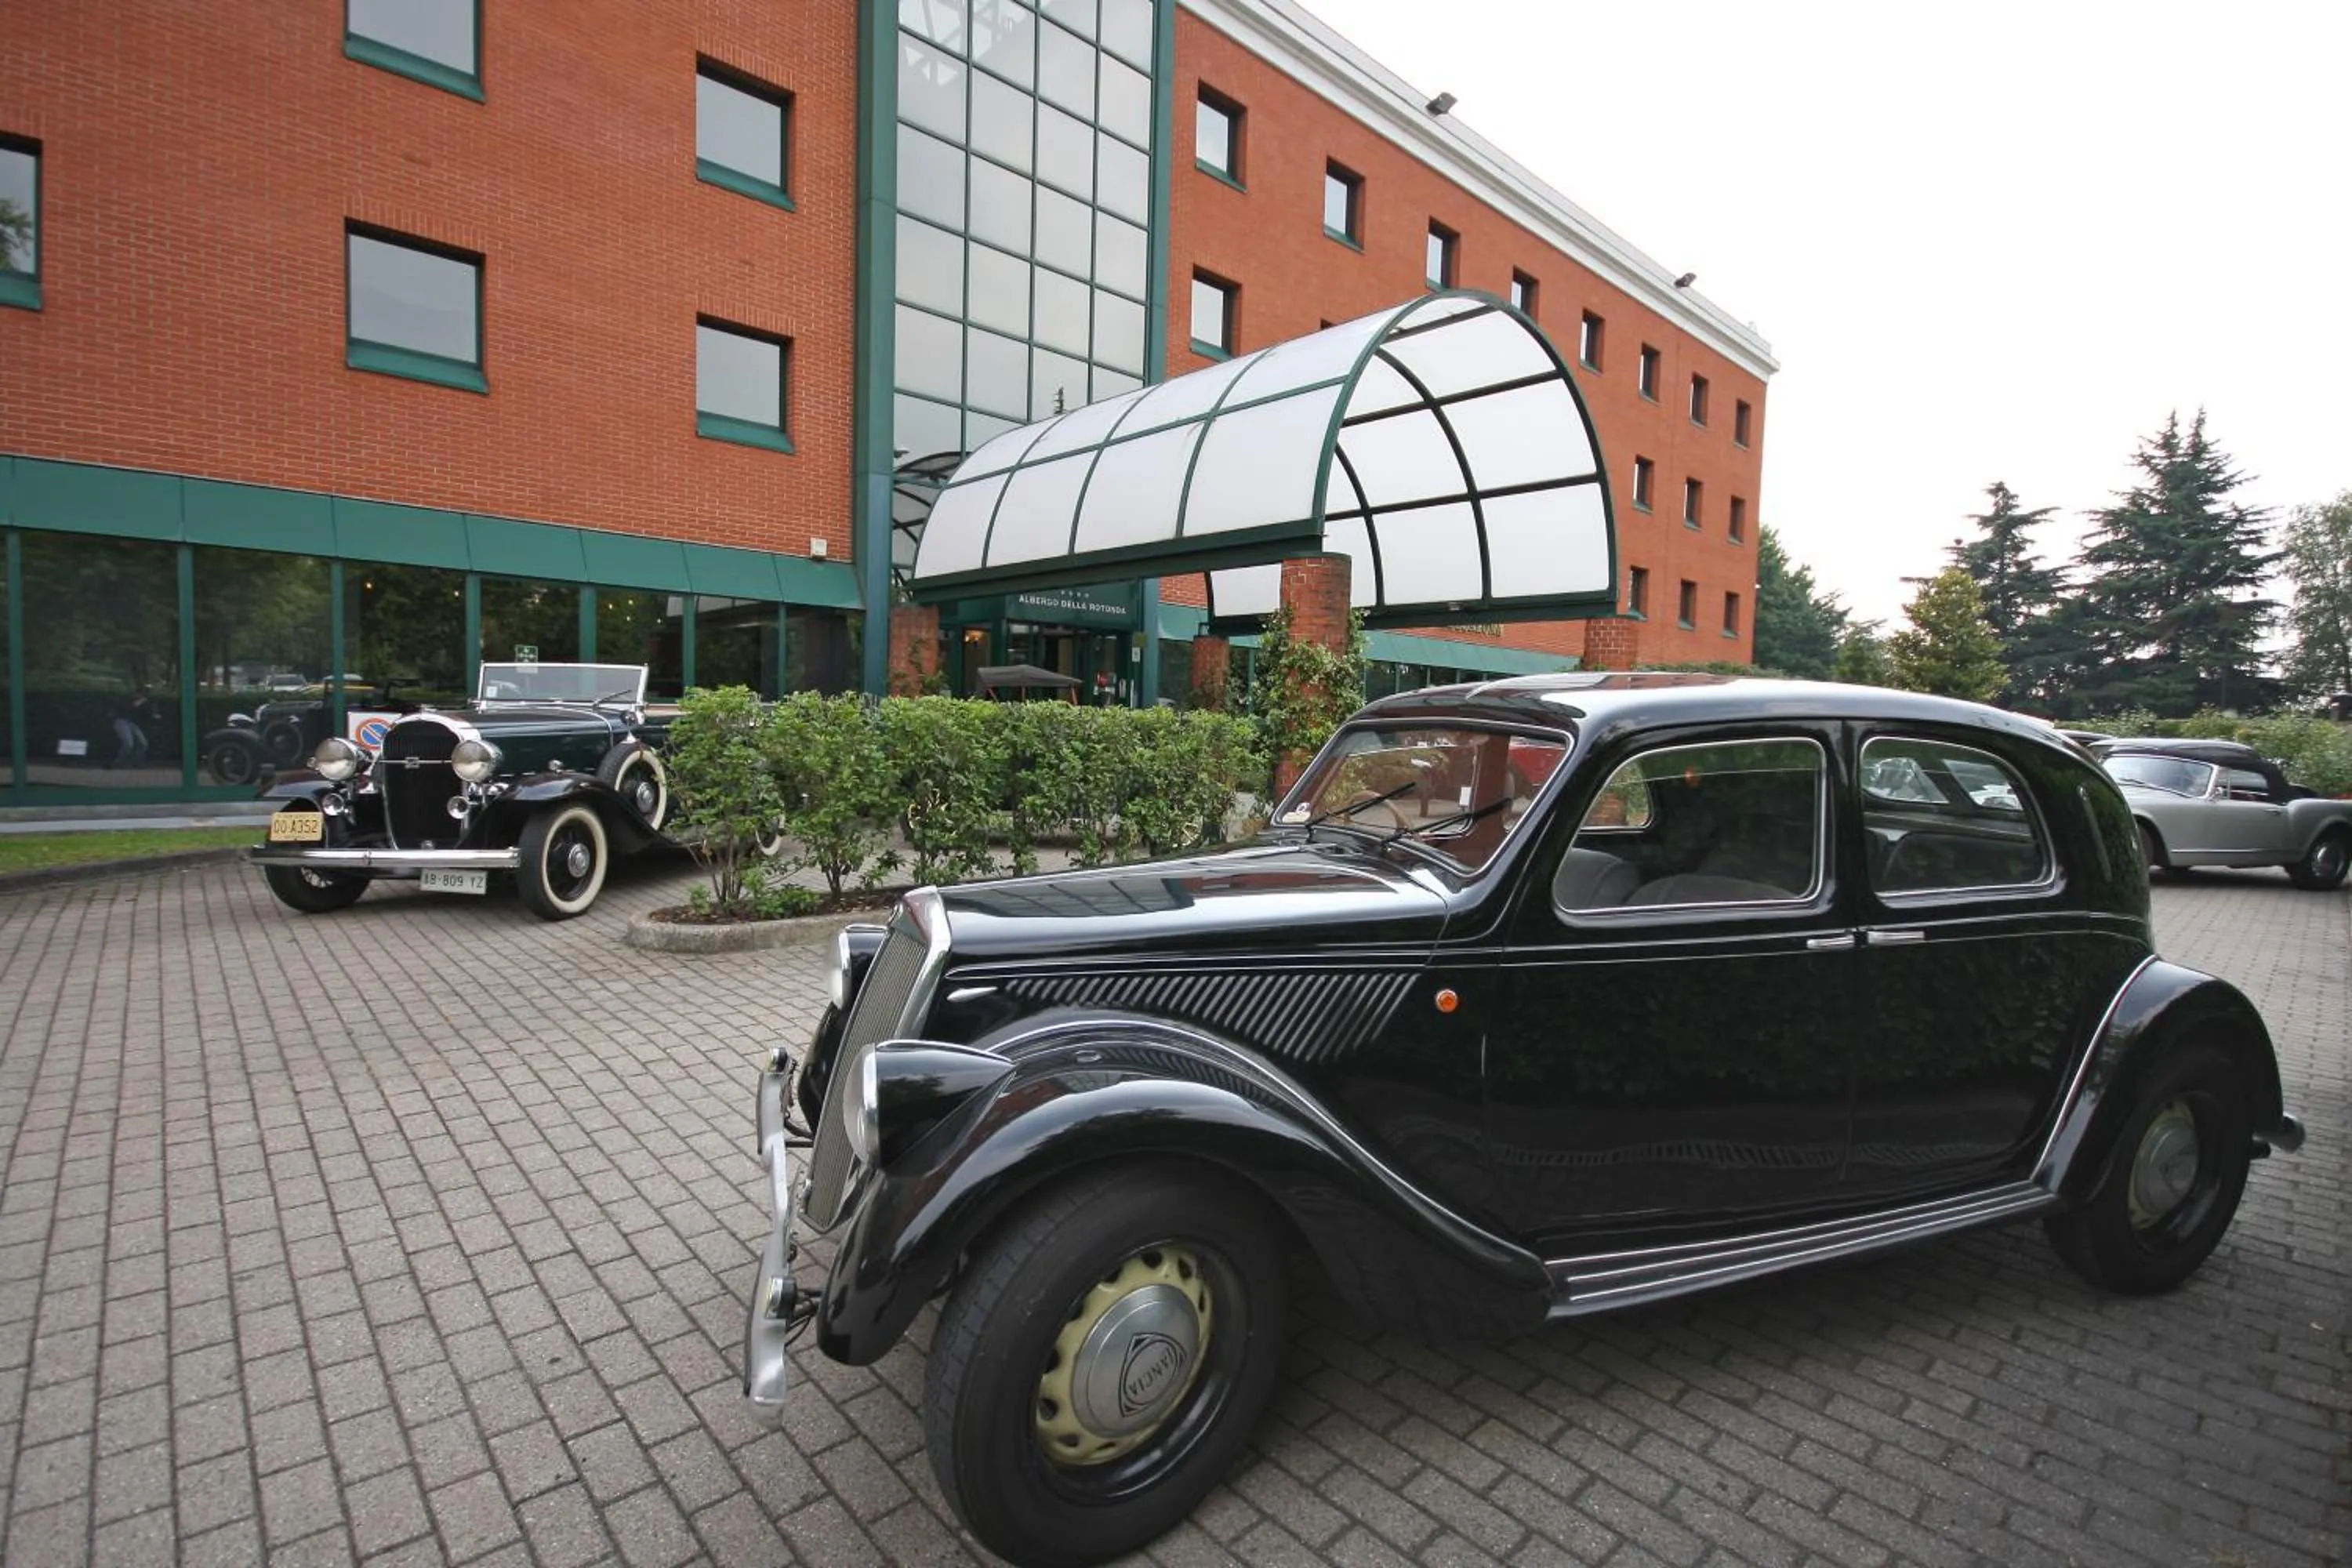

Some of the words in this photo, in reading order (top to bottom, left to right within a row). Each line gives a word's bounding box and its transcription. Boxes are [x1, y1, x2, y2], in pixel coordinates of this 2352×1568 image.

[1018, 593, 1058, 606] ALBERGO
[1061, 600, 1087, 610] DELLA
[1089, 603, 1127, 615] ROTONDA
[1128, 1347, 1174, 1396] LANCIA
